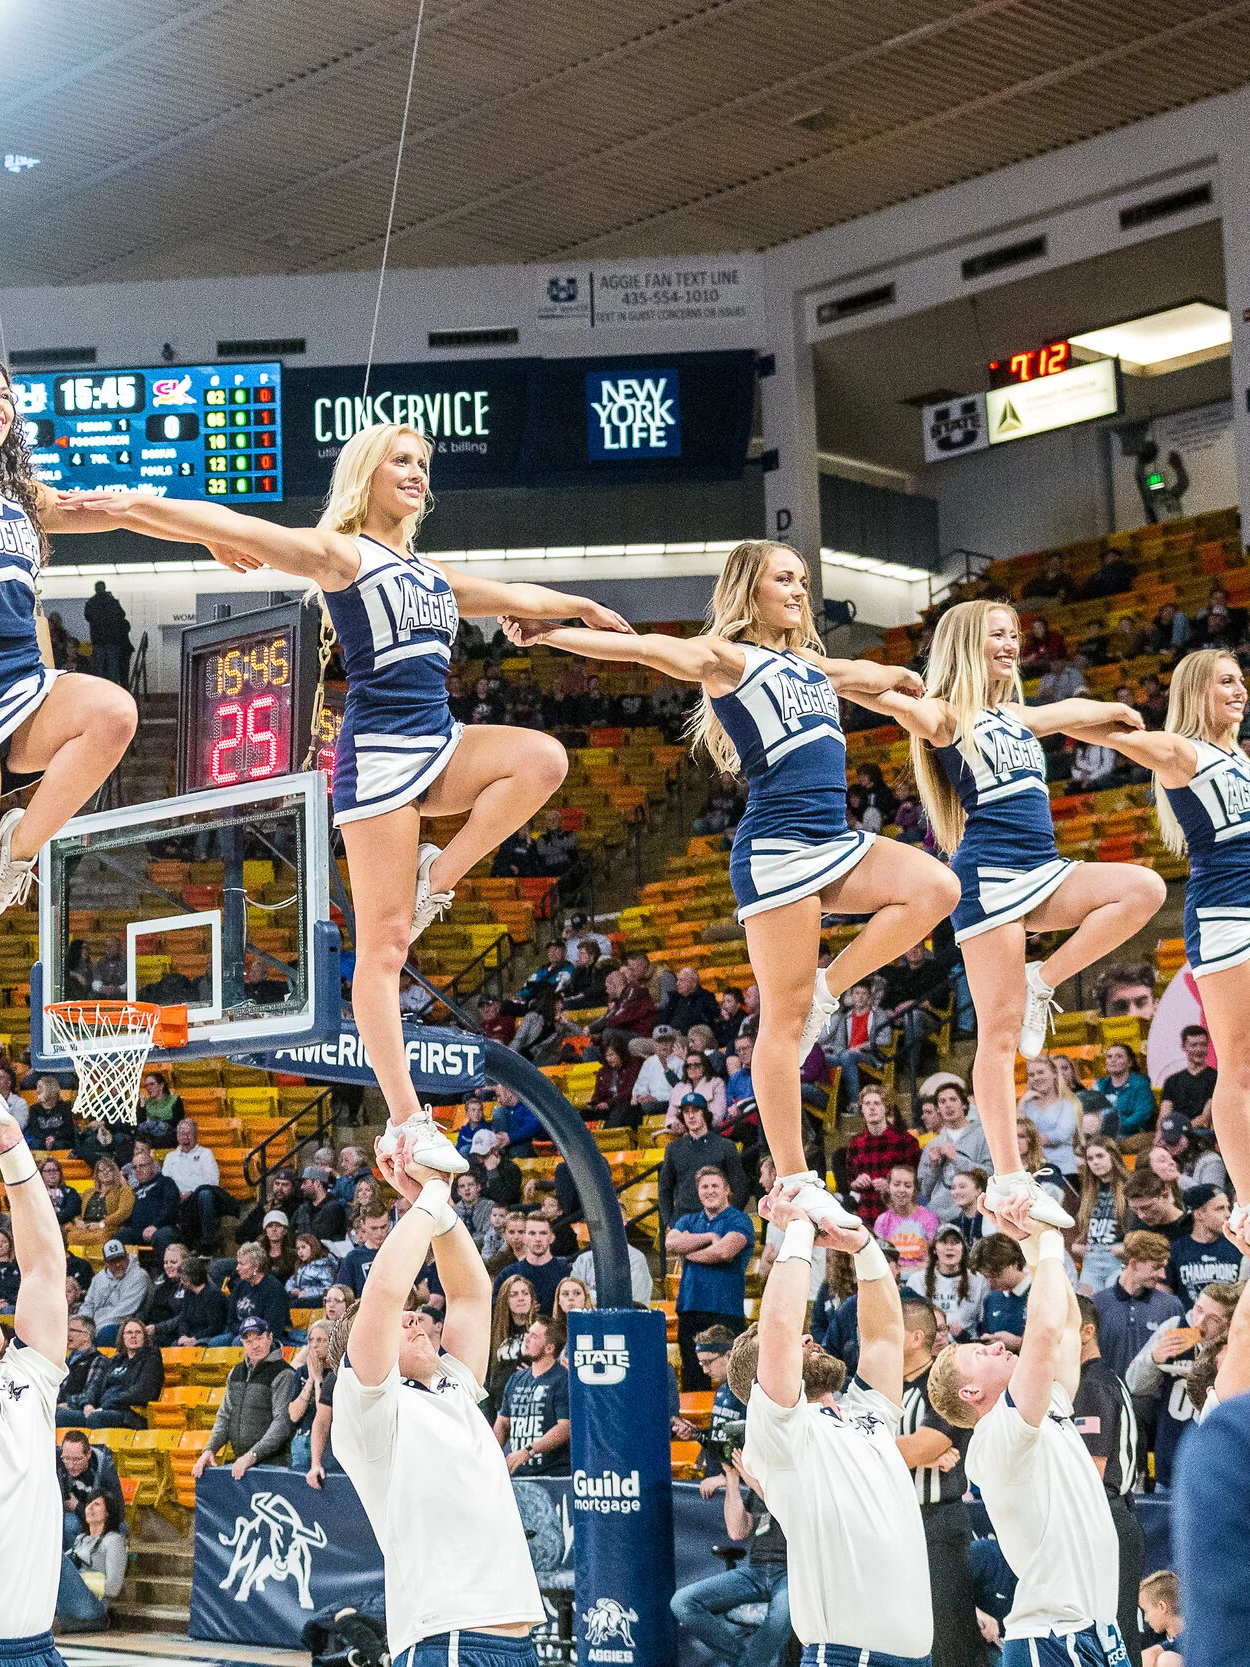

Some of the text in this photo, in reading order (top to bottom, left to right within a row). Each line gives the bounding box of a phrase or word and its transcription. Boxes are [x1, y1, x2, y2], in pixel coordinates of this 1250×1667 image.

[644, 273, 672, 288] FAN
[676, 271, 706, 287] TEXT
[711, 269, 739, 285] LINE
[60, 376, 136, 410] 15:45
[600, 378, 667, 405] NEW
[315, 391, 490, 442] CONSERVICE
[590, 398, 676, 428] YORK
[118, 418, 128, 431] 1
[163, 415, 180, 439] 0
[603, 422, 668, 449] LIFE
[71, 452, 82, 466] 4
[119, 451, 130, 463] 4
[450, 441, 488, 455] billing
[181, 462, 191, 476] 3
[208, 456, 227, 472] 12
[207, 478, 227, 494] 32
[777, 509, 791, 531] D
[217, 639, 290, 697] 15:45
[211, 694, 279, 787] 25
[405, 1040, 480, 1077] FIRST
[1180, 1263, 1239, 1285] CHAMPIONS
[574, 1350, 631, 1369] STATE
[509, 1415, 544, 1438] TRUE
[573, 1469, 640, 1498] Guild
[574, 1498, 641, 1514] mortgage
[588, 1648, 634, 1664] AGGIES
